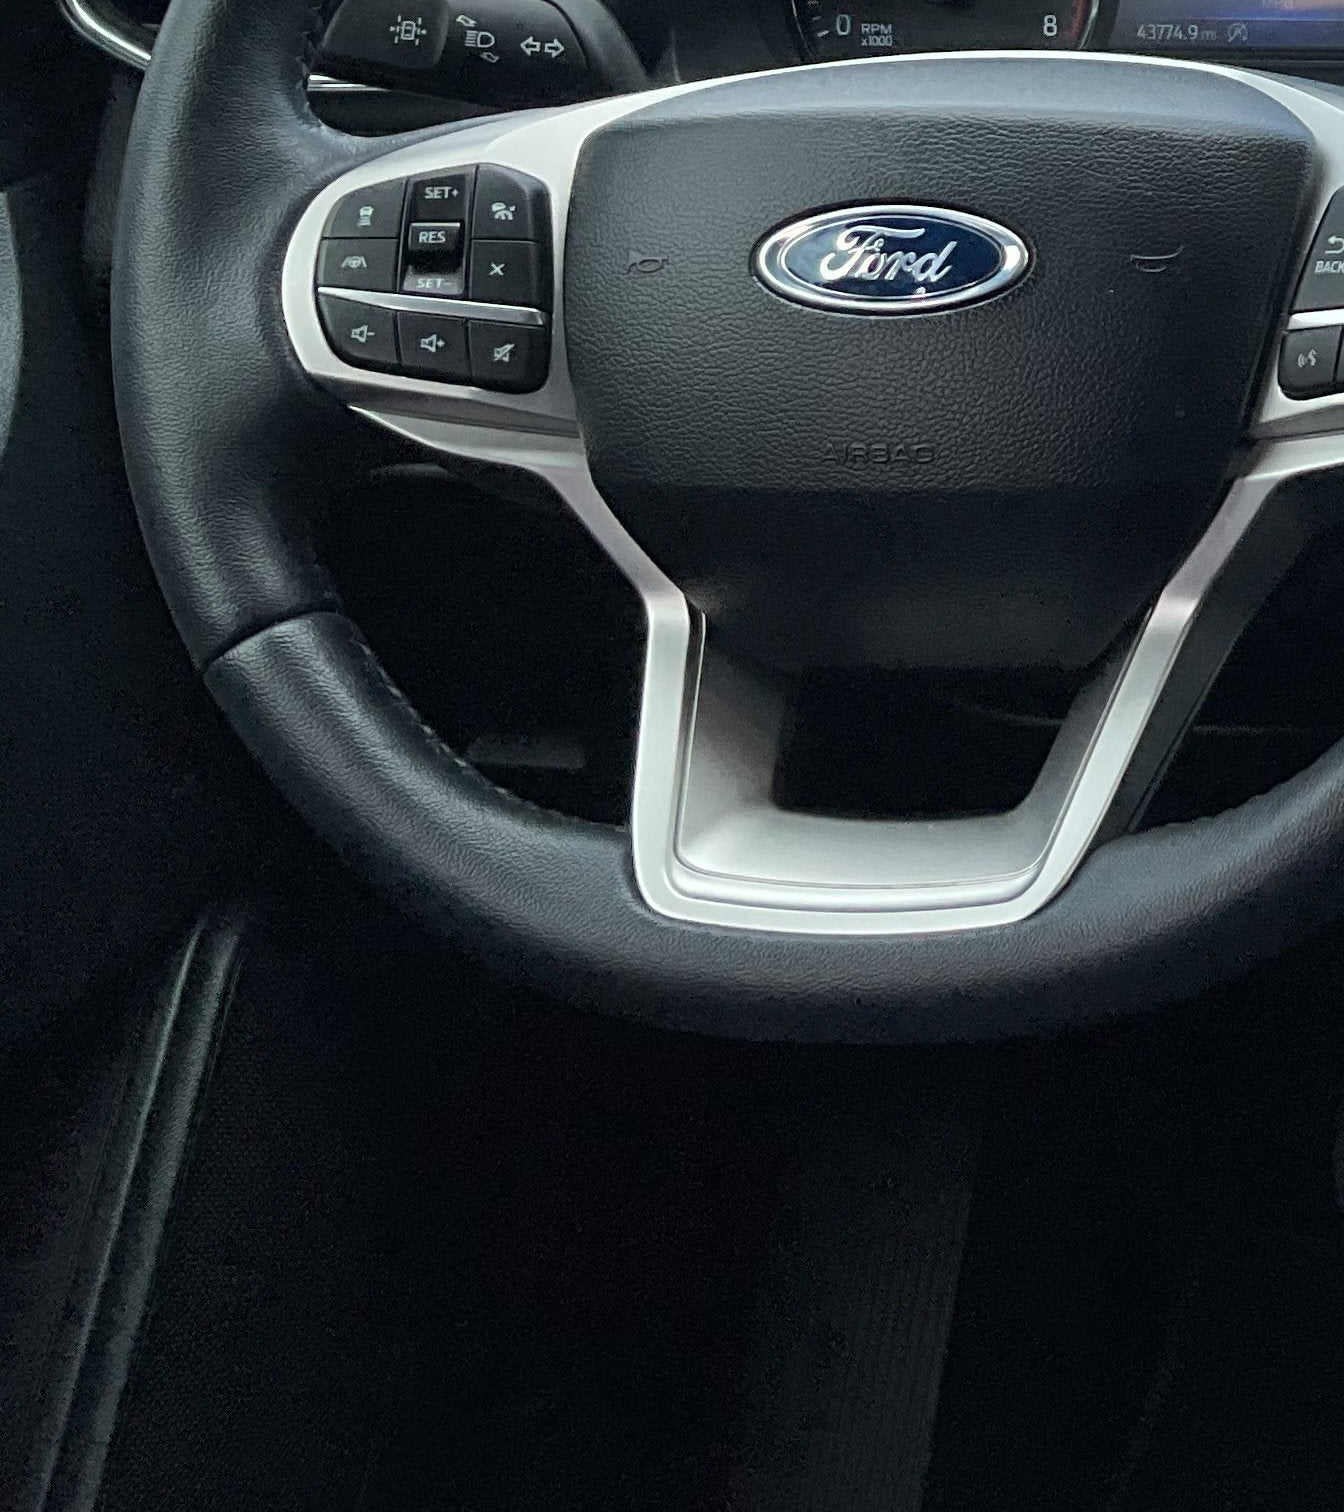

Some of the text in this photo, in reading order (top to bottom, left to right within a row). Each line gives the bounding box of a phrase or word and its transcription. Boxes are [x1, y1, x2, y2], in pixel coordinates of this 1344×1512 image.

[836, 14, 851, 36] 0
[861, 23, 892, 35] RPM
[1043, 14, 1058, 37] 8
[1136, 24, 1199, 41] 43774.9
[418, 230, 446, 244] RES
[819, 224, 958, 283] Ford
[824, 439, 937, 464] AIRBAG
